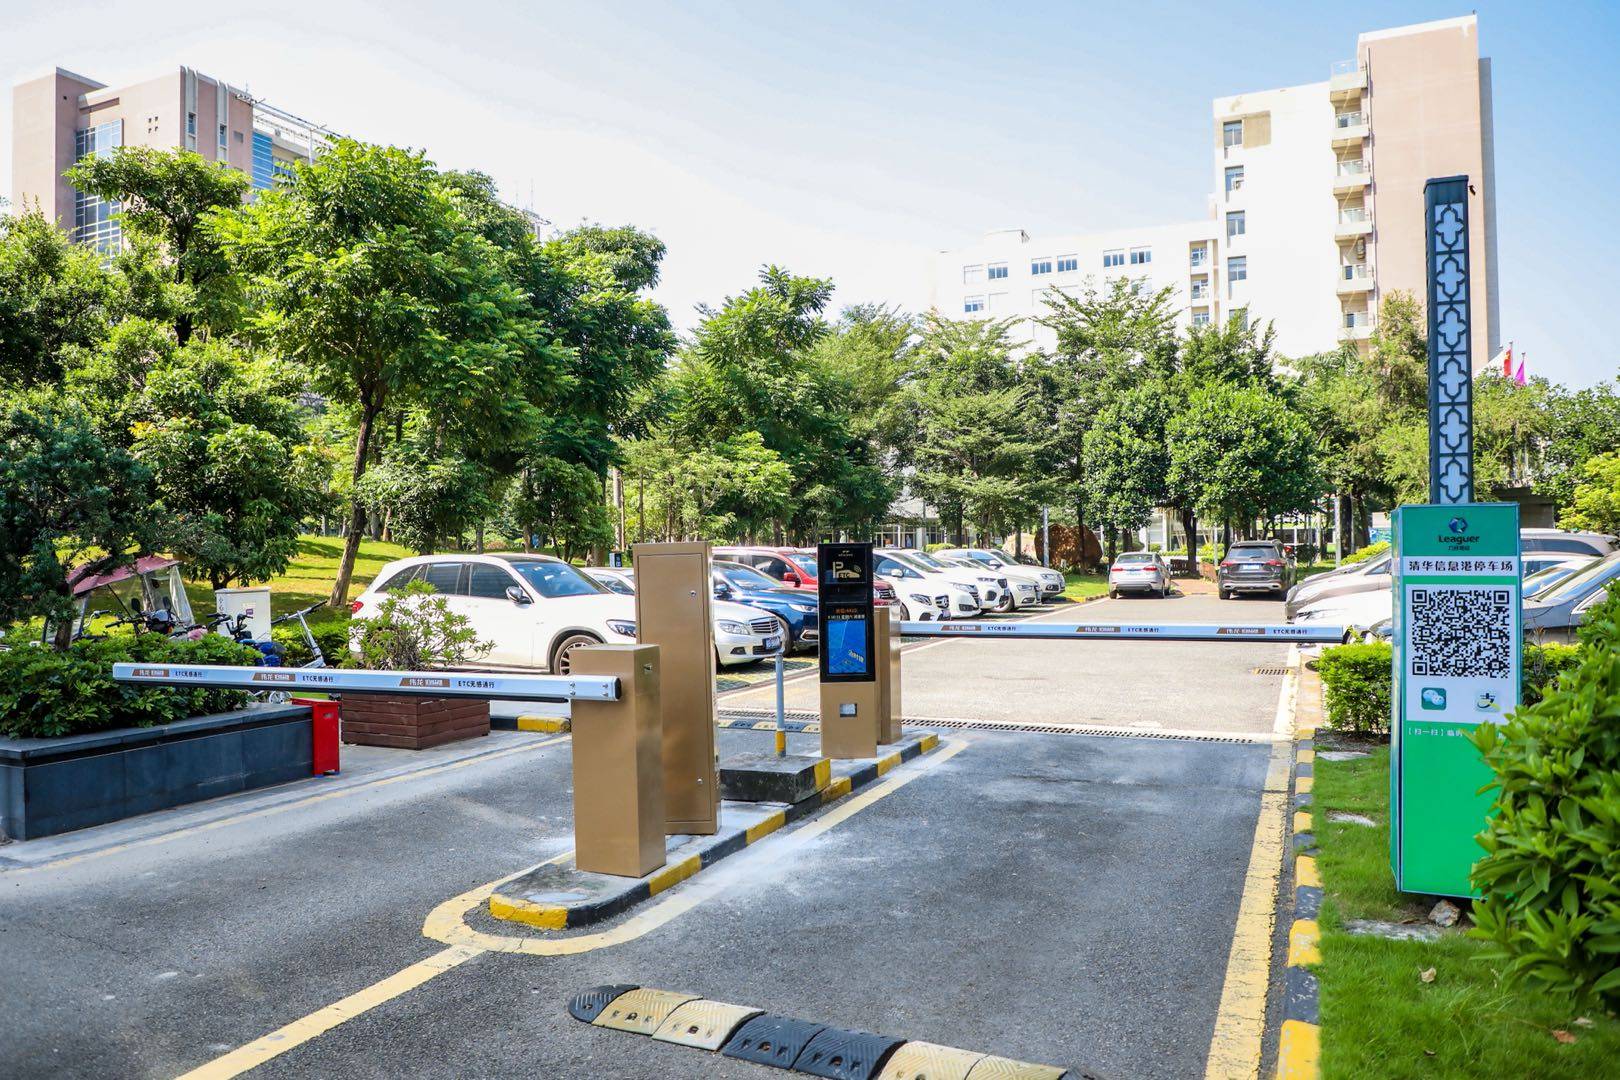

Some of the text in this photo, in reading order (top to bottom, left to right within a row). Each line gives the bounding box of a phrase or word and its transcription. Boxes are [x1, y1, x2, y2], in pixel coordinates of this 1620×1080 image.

[1438, 535, 1480, 545] Leaguer
[1409, 560, 1513, 572] 清华信息港停车场
